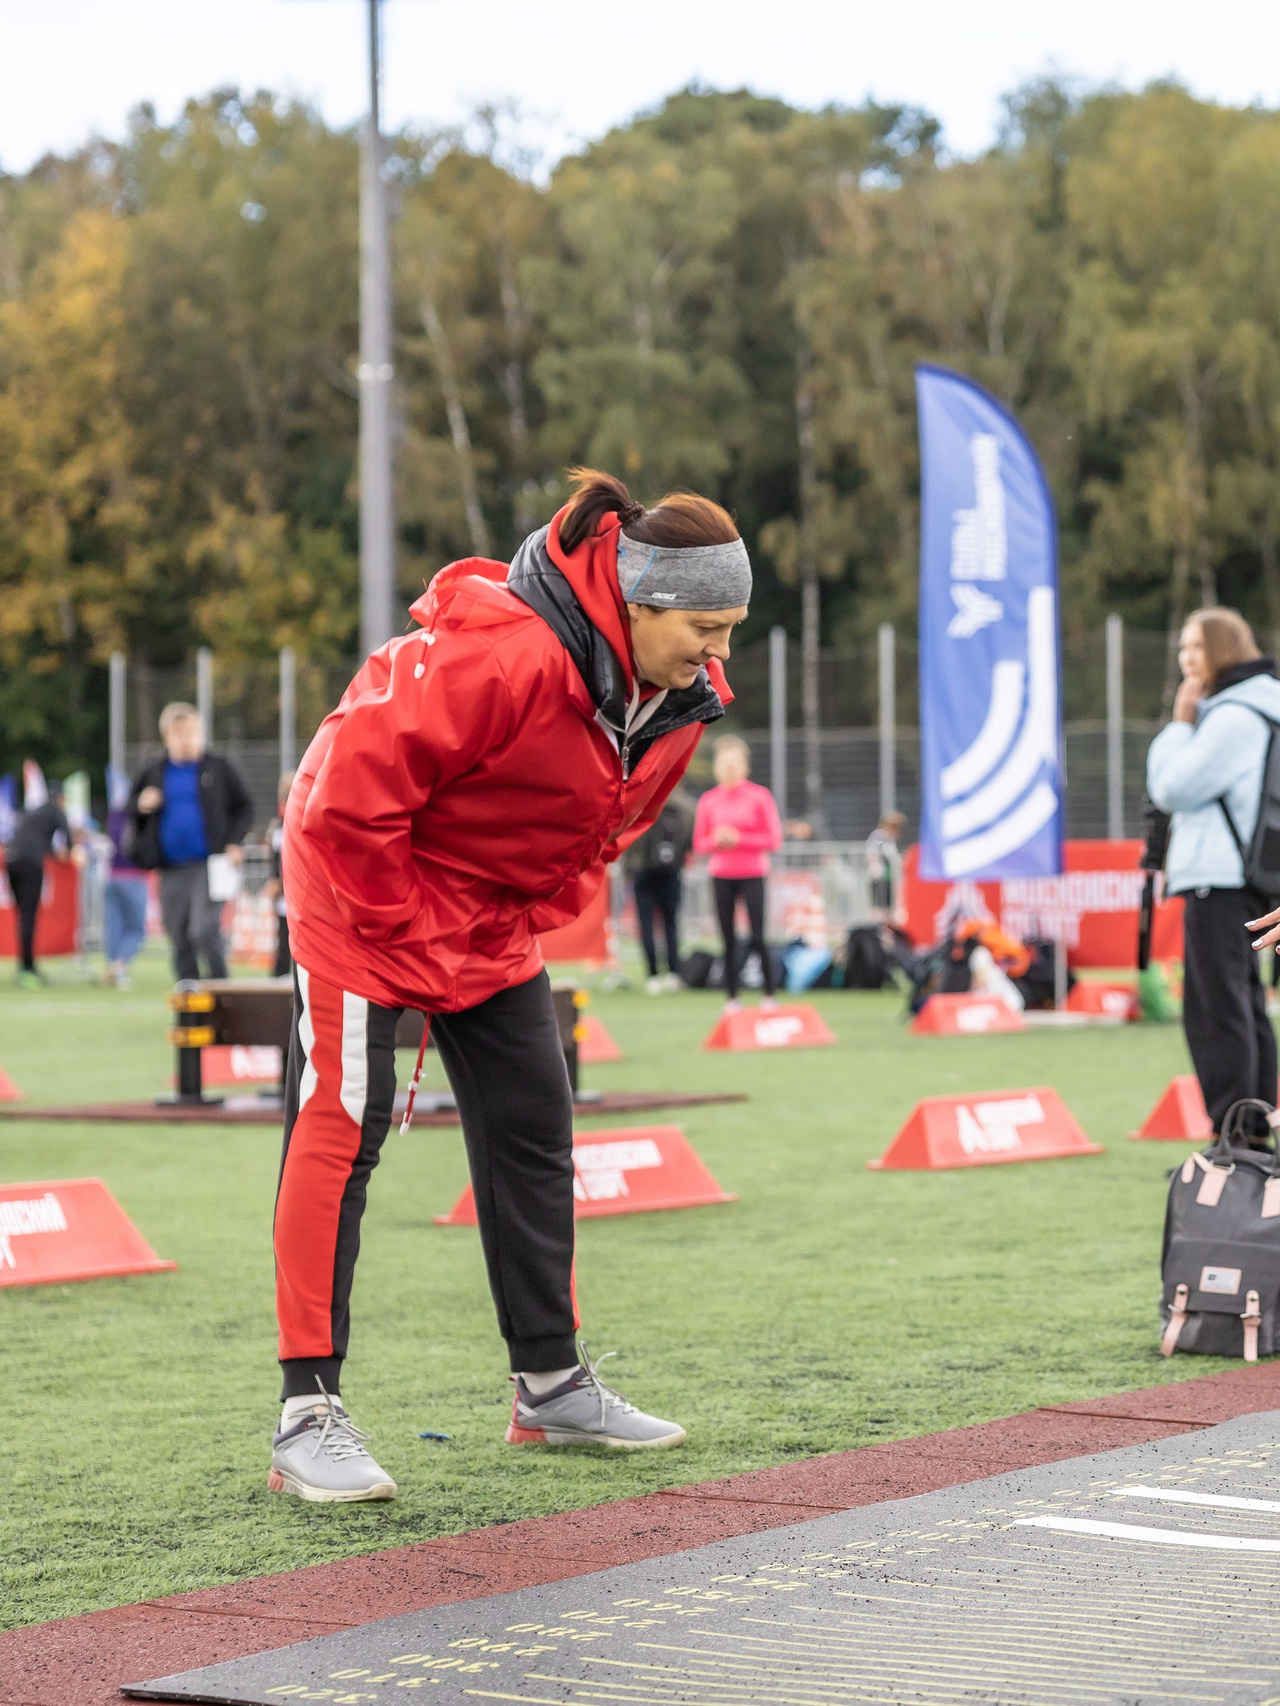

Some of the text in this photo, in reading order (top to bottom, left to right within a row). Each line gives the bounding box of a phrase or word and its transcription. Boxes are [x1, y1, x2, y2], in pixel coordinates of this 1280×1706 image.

[1014, 1499, 1091, 1510] 170
[976, 1509, 1054, 1517] 80
[935, 1519, 1014, 1531] 190
[887, 1530, 983, 1543] 200
[845, 1541, 941, 1556] 210
[800, 1552, 898, 1567] 220
[757, 1563, 851, 1578] 230
[710, 1574, 810, 1591] 240
[663, 1587, 765, 1603] 250
[612, 1598, 716, 1616] 260
[560, 1611, 666, 1628] 270
[505, 1623, 613, 1641] 280
[448, 1638, 558, 1656] 290
[389, 1654, 500, 1673] 300
[328, 1668, 440, 1688] 310
[264, 1685, 377, 1704] 320
